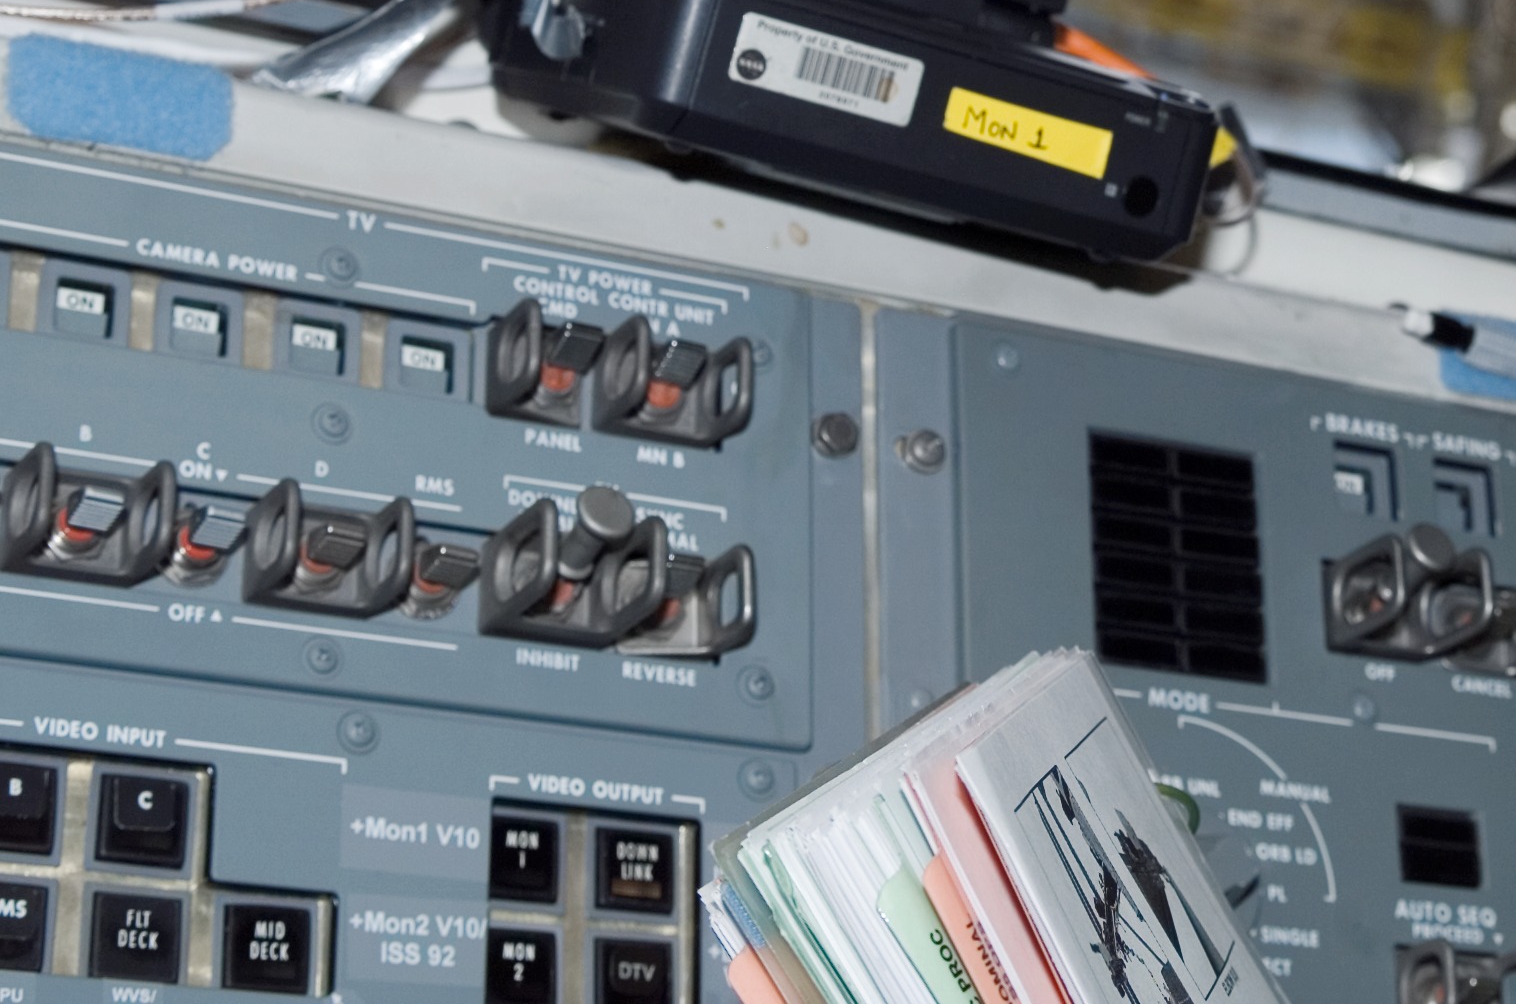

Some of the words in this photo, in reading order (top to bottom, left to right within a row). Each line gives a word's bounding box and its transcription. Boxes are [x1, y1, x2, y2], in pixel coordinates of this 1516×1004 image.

[757, 19, 803, 42] Property
[844, 43, 910, 72] Government
[1028, 126, 1048, 150] 1
[347, 209, 377, 233] TV
[136, 238, 221, 270] CAMERA
[227, 253, 298, 283] POWER
[557, 264, 582, 283] TV
[588, 270, 653, 296] POWER
[66, 293, 95, 310] ON
[513, 275, 600, 306] CONTROL
[674, 303, 715, 326] UNIT
[182, 312, 210, 331] ON
[300, 331, 328, 347] ON
[410, 350, 437, 366] ON
[79, 425, 92, 442] B
[1325, 412, 1400, 443] BRAKES
[197, 442, 211, 461] C
[524, 428, 582, 452] PANEL
[1432, 431, 1501, 462] SAFING
[315, 461, 329, 477] D
[636, 446, 668, 466] MN
[673, 450, 685, 469] B
[179, 460, 212, 481] ON
[415, 474, 455, 497] RMS
[168, 605, 206, 623] OFF
[516, 648, 581, 673] INHIBIT
[1364, 661, 1396, 683] OFF
[622, 661, 697, 687] REVERSE
[1451, 674, 1513, 699] CANCEL
[1148, 688, 1211, 715] MODE
[34, 716, 99, 740] VIDEO
[107, 726, 167, 747] INPUT
[9, 778, 22, 796] B
[528, 773, 586, 796] VIDEO
[592, 780, 665, 806] OUTPUT
[1259, 778, 1332, 804] MANUAL
[137, 791, 153, 810] C
[1227, 807, 1263, 829] END
[1266, 812, 1295, 833] EFF
[350, 816, 428, 844] +Mon1
[436, 824, 481, 849] V10
[505, 829, 539, 850] MON
[616, 841, 660, 861] DOWN
[1255, 842, 1292, 863] ORB
[620, 862, 654, 882] LINK
[126, 909, 152, 928] FLT
[1394, 898, 1453, 924] AUTO
[1457, 904, 1498, 930] SEQ
[117, 929, 159, 951] DECK
[254, 920, 286, 940] MID
[1260, 924, 1319, 949] SINGLE
[249, 940, 289, 962] DECK
[380, 941, 422, 966] ISS
[427, 945, 456, 968] 92
[503, 942, 536, 962] MON
[930, 927, 972, 993] PROC
[966, 915, 1012, 1003] OMINAL
[513, 962, 525, 982] 2
[618, 961, 657, 983] DTV
